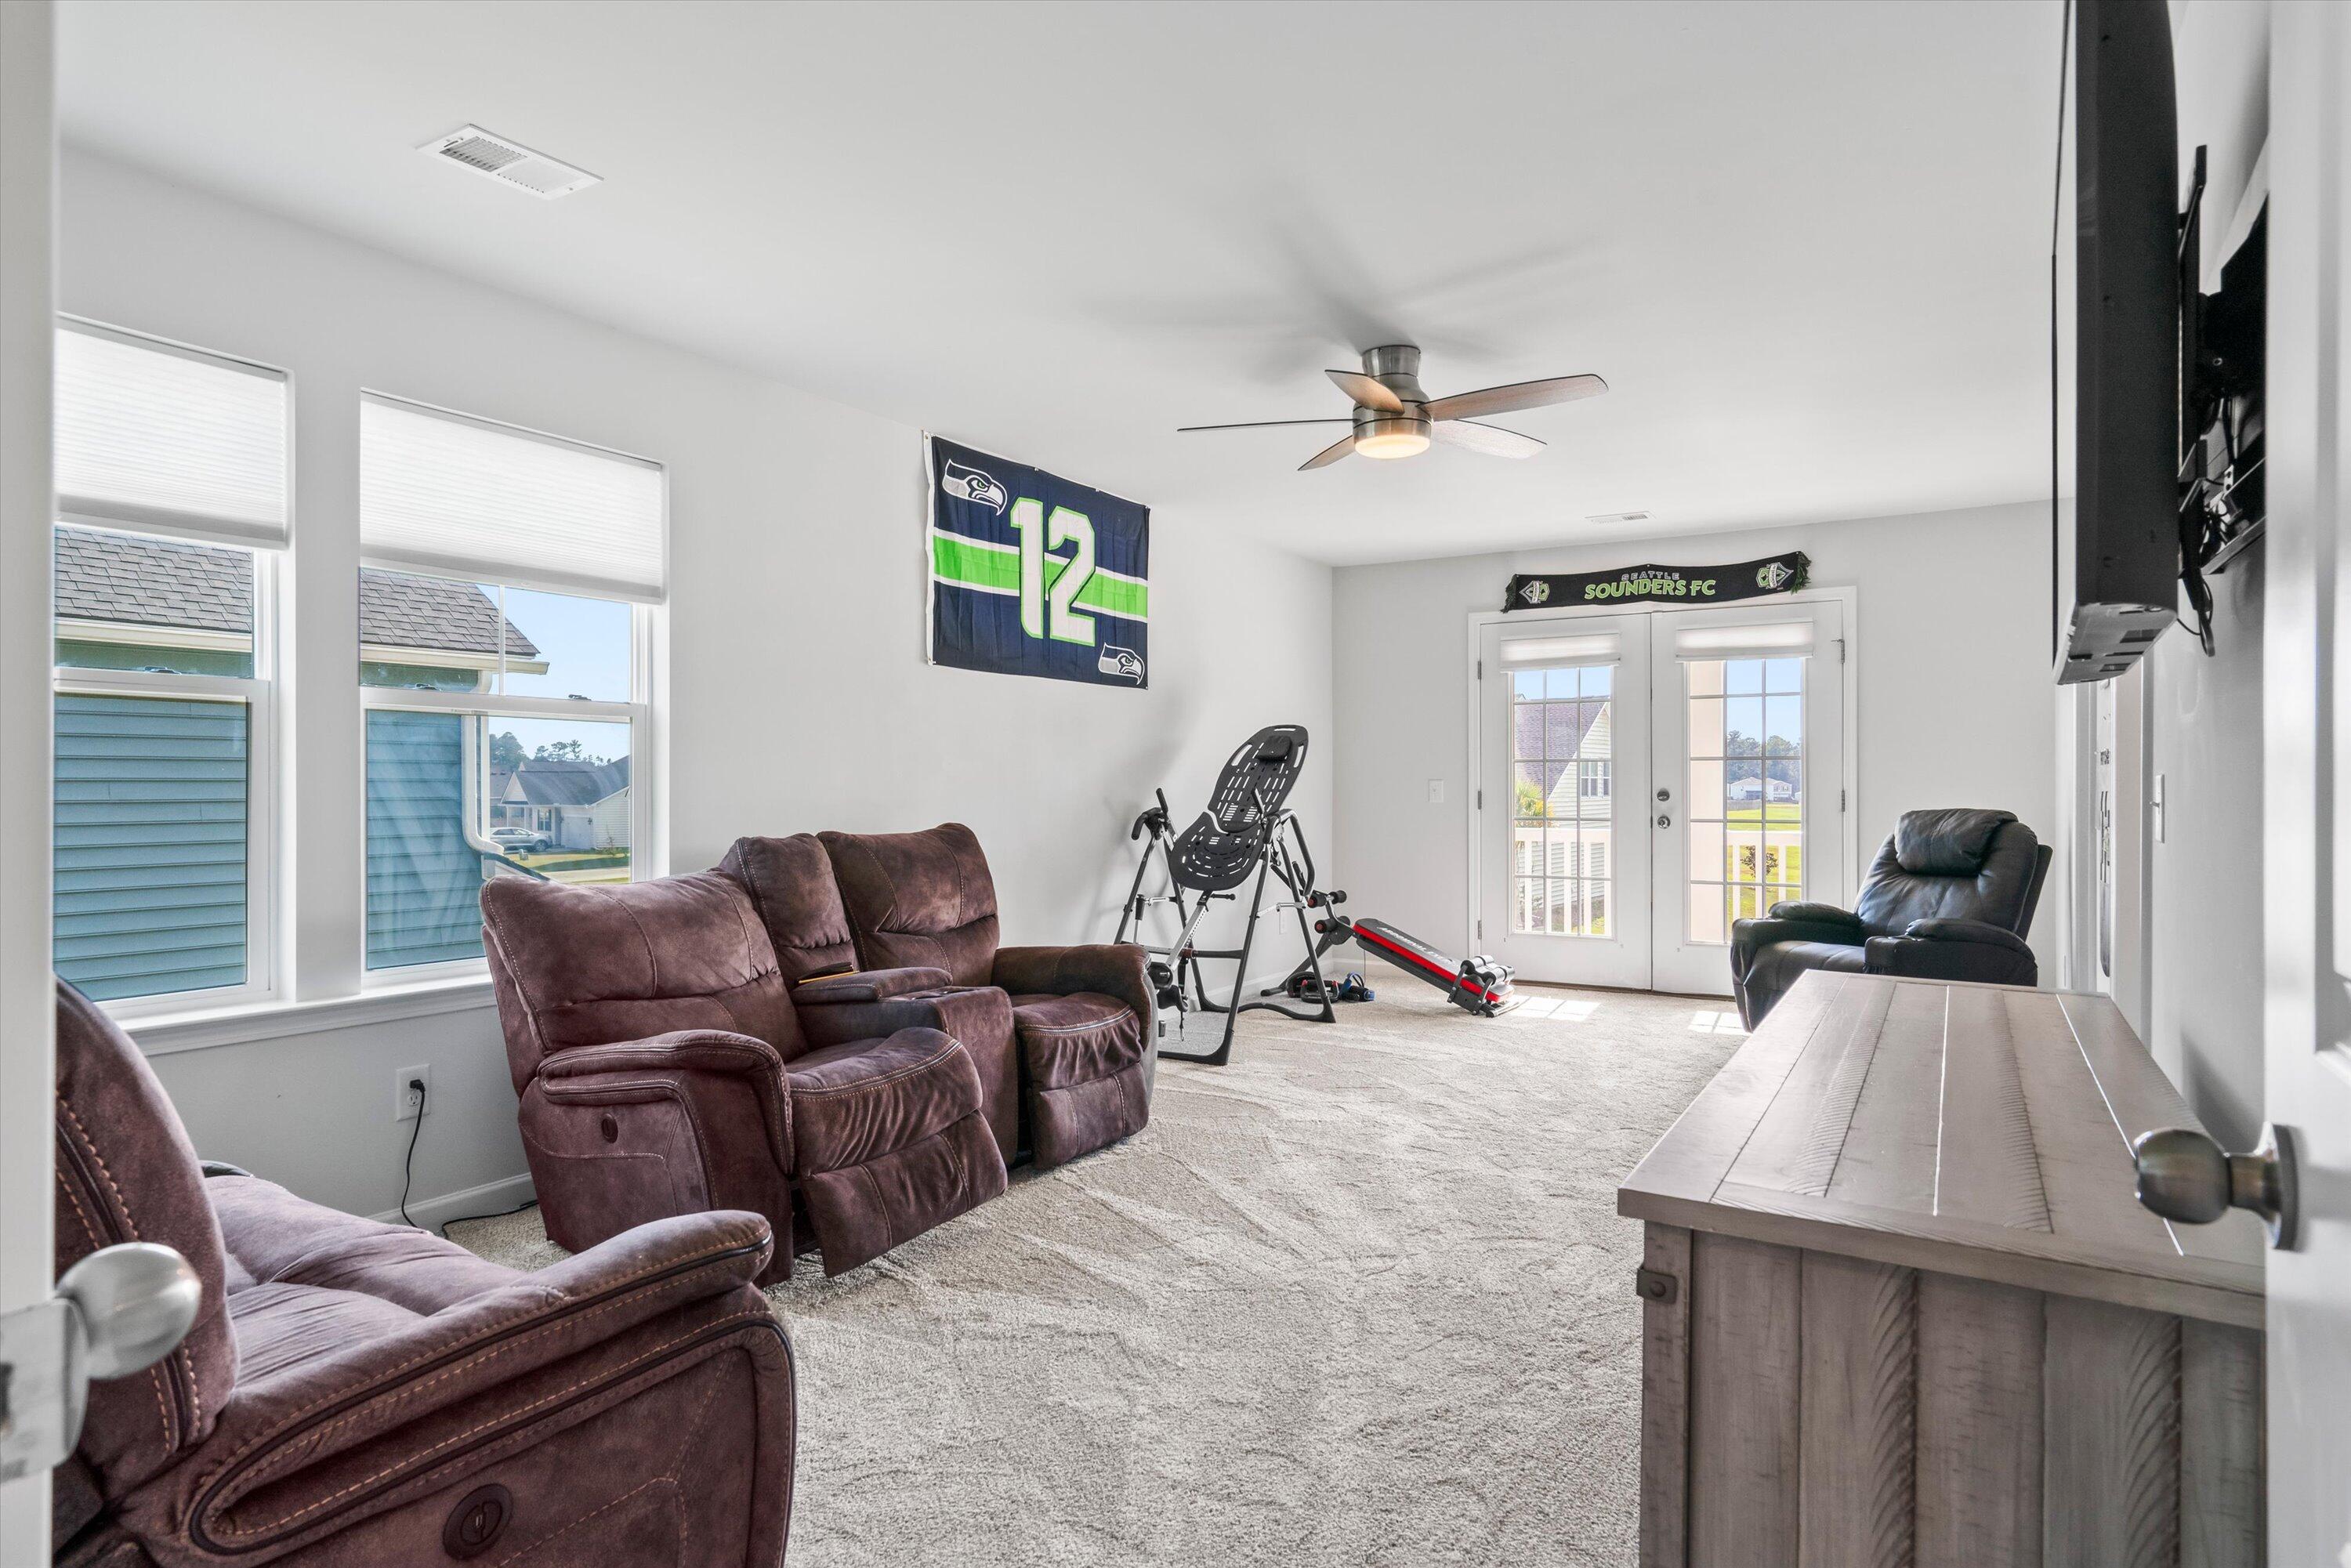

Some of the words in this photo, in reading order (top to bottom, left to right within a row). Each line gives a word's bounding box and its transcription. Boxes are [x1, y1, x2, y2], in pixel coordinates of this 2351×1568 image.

[1010, 497, 1096, 647] 12
[1621, 570, 1679, 581] SEATTLE
[1584, 578, 1686, 599] SOUNDERS
[1690, 580, 1716, 596] FC
